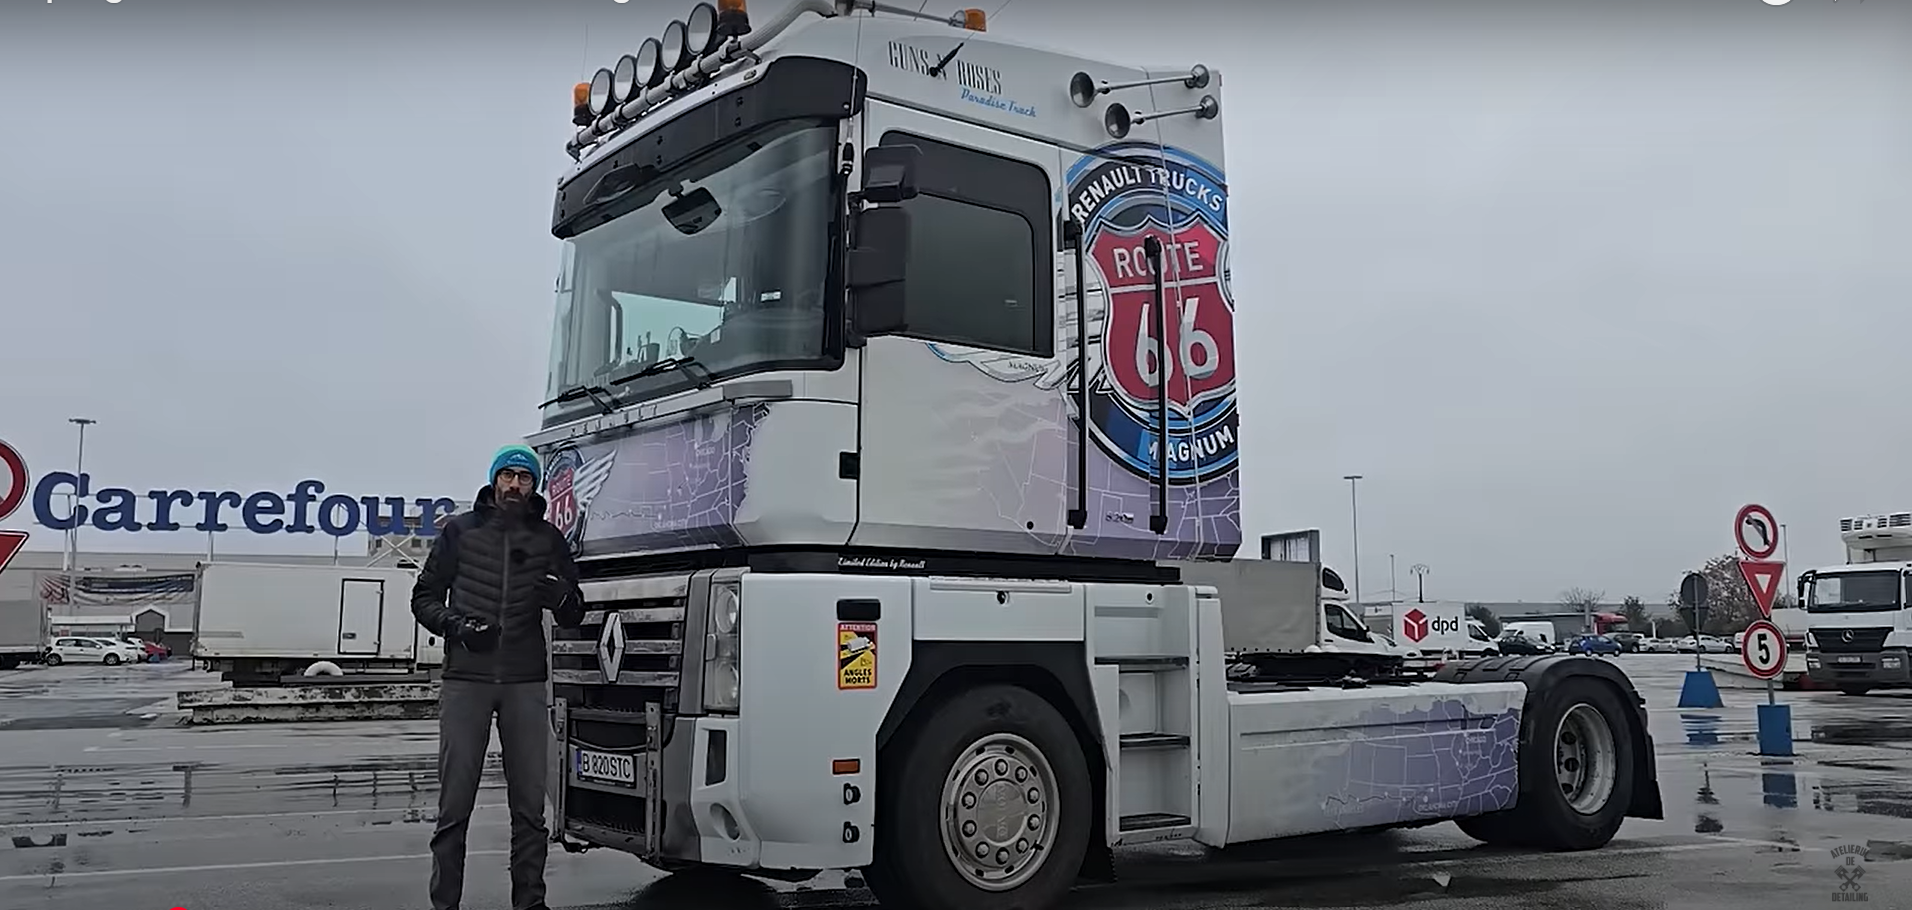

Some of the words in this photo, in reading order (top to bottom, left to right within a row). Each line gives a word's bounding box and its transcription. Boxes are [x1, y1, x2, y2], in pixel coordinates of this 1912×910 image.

[888, 41, 930, 76] GUNS
[955, 59, 1001, 95] ROSES
[961, 88, 1006, 111] Paradise
[1008, 101, 1036, 118] Truck
[1071, 165, 1143, 223] RENAULT
[1146, 166, 1223, 212] TRUCKS
[1135, 297, 1219, 387] 66
[1149, 424, 1234, 463] MAGNUM
[33, 471, 456, 537] Carrefour
[555, 495, 573, 529] 66
[838, 557, 866, 567] Limited
[866, 557, 888, 567] Edition
[890, 559, 898, 569] by
[899, 559, 926, 568] Renault
[1431, 616, 1458, 635] dpd
[1757, 633, 1770, 665] 5
[843, 668, 872, 677] ANGLES
[845, 676, 871, 684] MORTS
[582, 753, 590, 772] B
